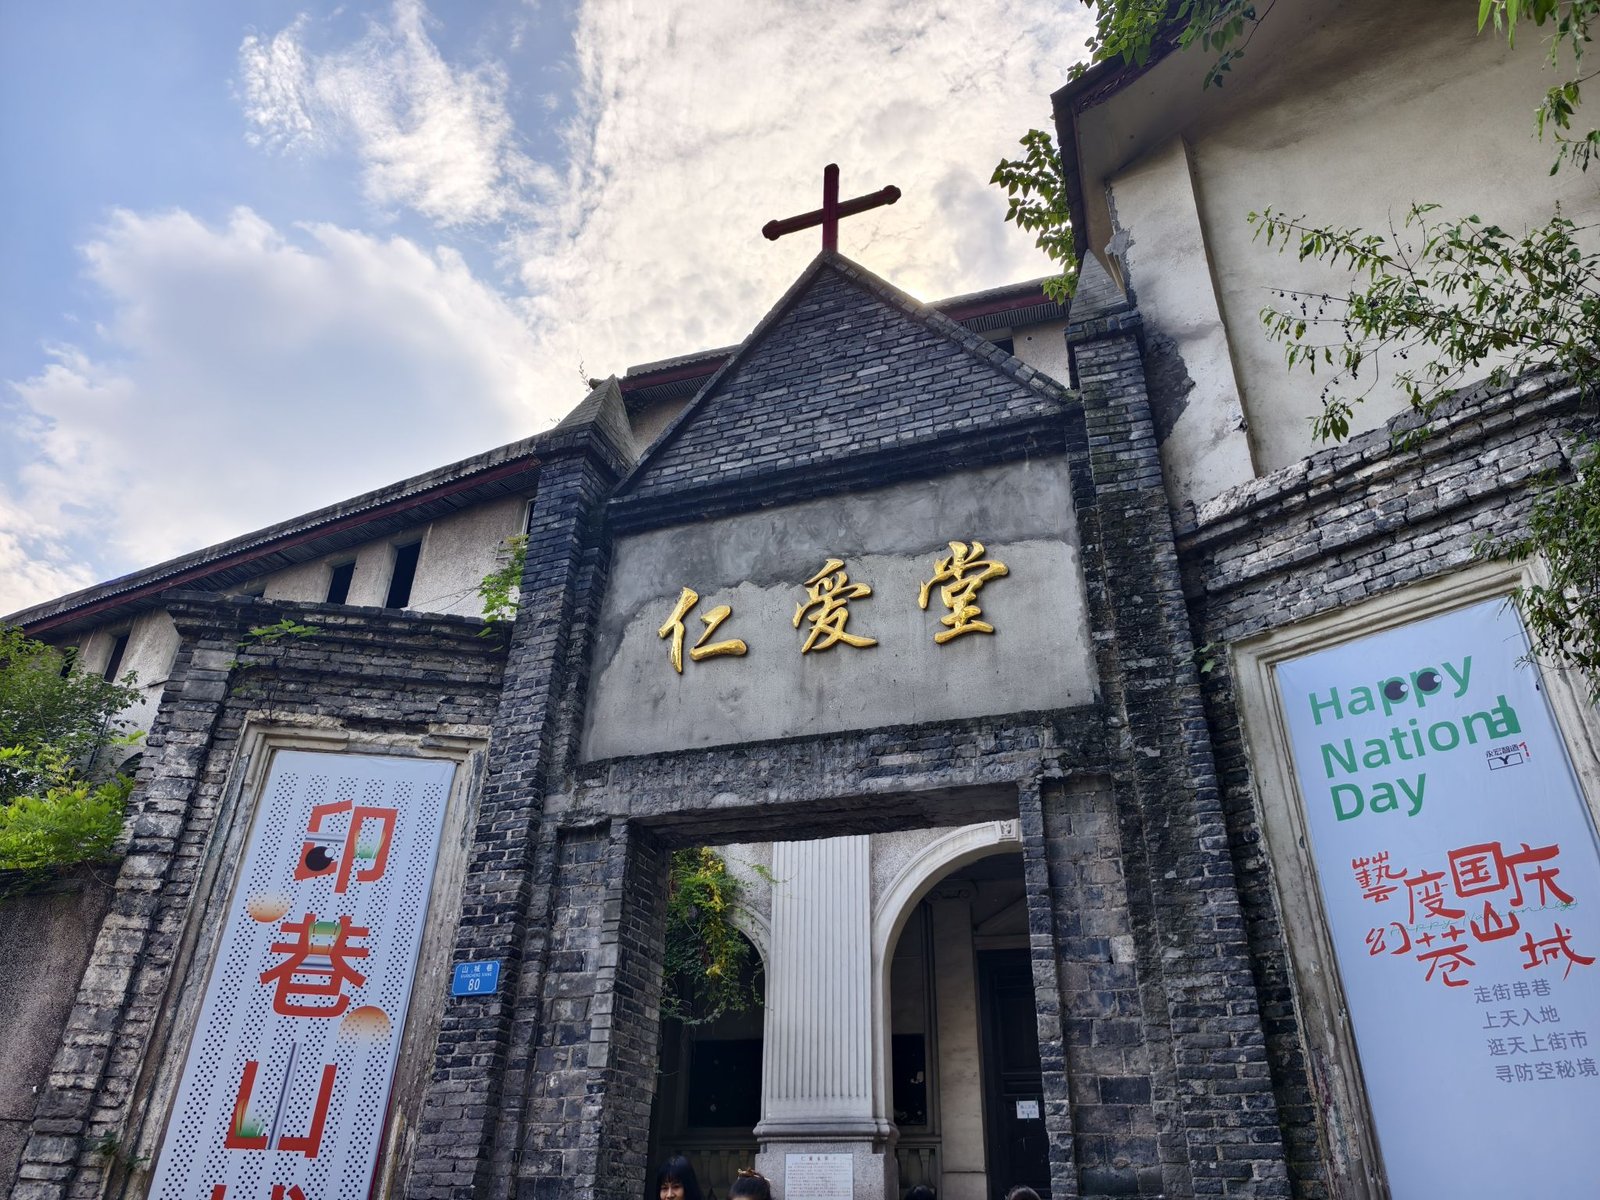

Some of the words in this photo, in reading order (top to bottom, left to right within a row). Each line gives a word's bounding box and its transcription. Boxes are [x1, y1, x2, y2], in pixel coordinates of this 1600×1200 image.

[658, 541, 1010, 673] 仁爱堂
[1309, 656, 1472, 725] Happy
[1320, 695, 1521, 779] National
[1330, 773, 1426, 821] Day
[211, 800, 398, 1200] 印巷山
[468, 978, 481, 991] 80
[1474, 978, 1551, 1004] 走街串巷
[1482, 1005, 1560, 1029] 上天入地
[1487, 1030, 1588, 1056] 逛天上街市
[1495, 1057, 1599, 1083] 寻防空秘境
